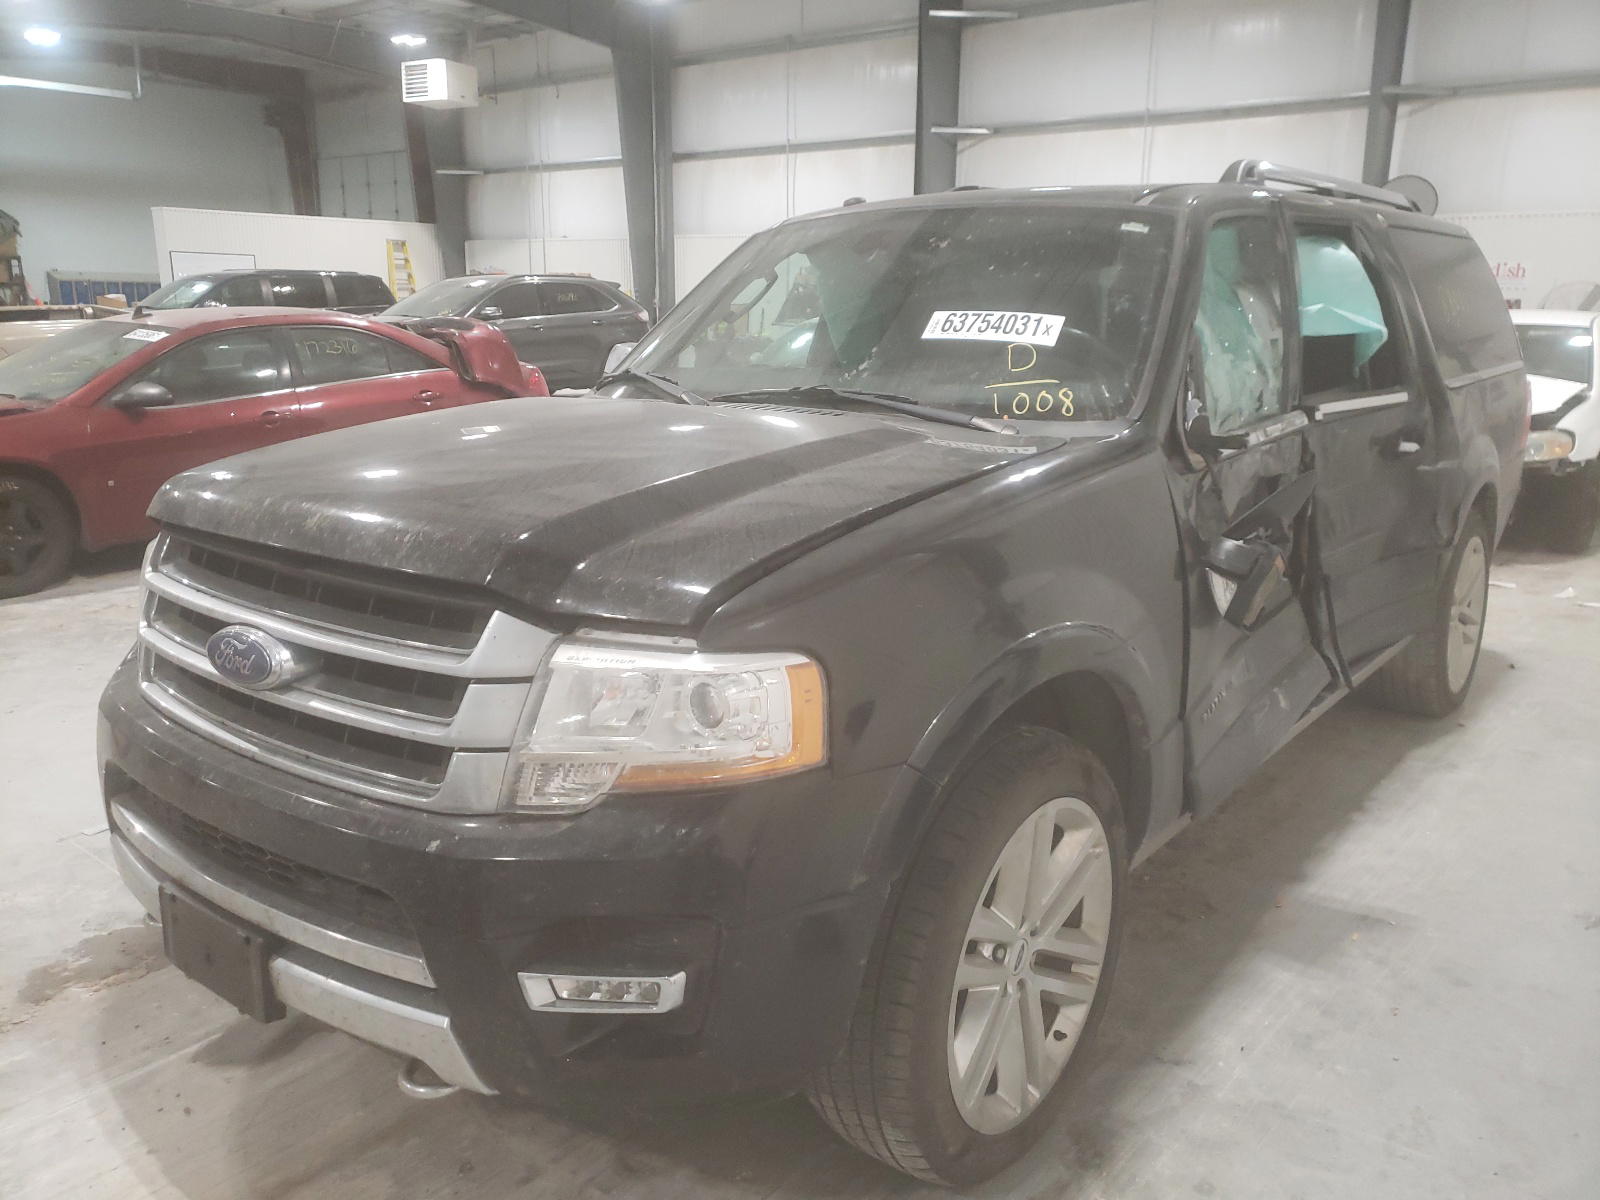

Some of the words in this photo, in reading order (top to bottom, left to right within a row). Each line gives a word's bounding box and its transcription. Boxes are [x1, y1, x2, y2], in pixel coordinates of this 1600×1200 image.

[941, 312, 1043, 337] 63754031
[1007, 342, 1037, 372] D
[993, 387, 1074, 417] 1008
[215, 637, 256, 675] Ford
